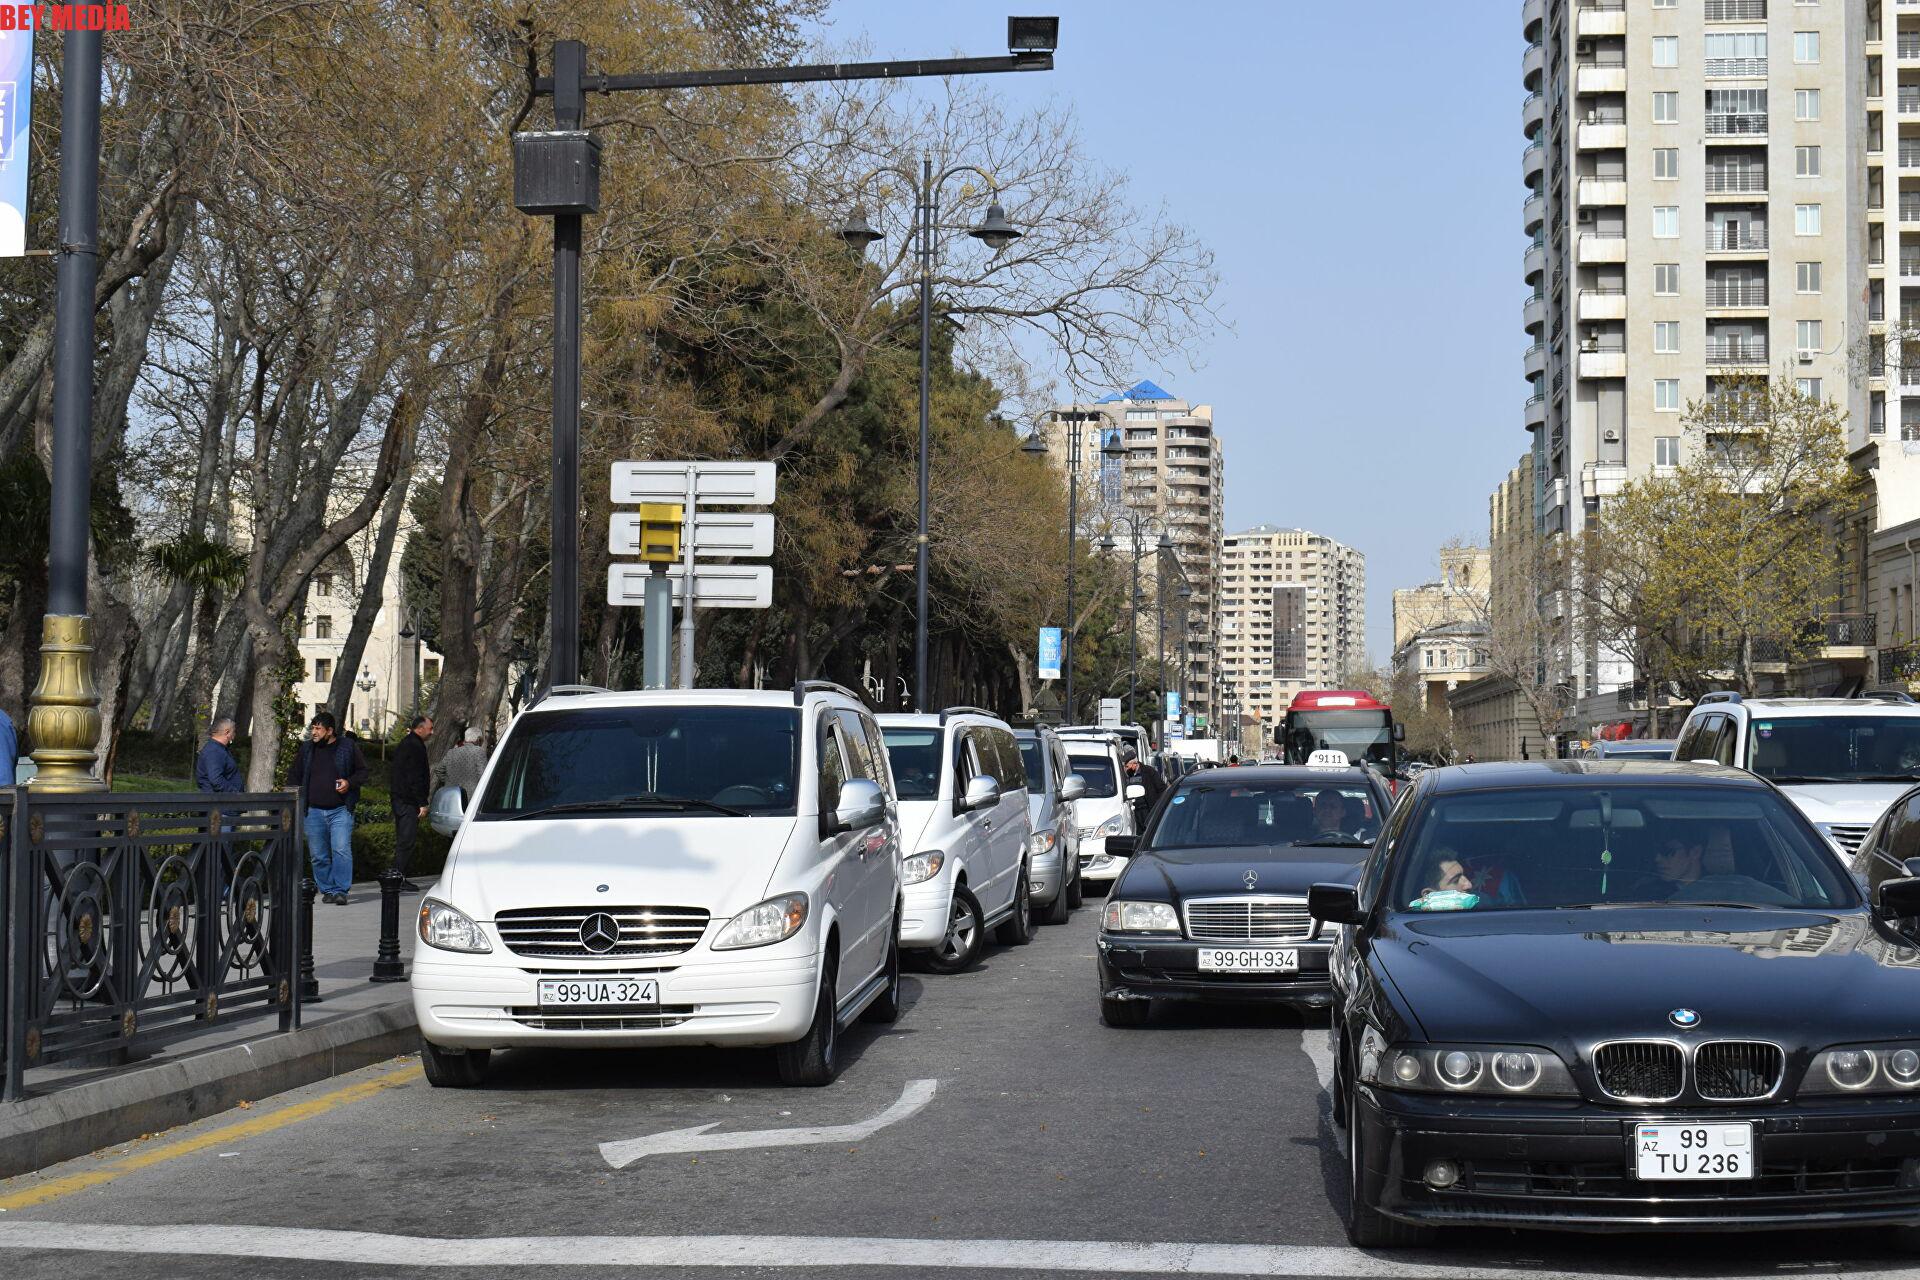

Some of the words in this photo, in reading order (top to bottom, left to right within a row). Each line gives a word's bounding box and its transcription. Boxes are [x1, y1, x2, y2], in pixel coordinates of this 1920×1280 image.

[1214, 951, 1294, 967] 99-GH-934
[543, 993, 554, 1001] AZ
[557, 982, 652, 1002] 99-UA-324
[1642, 1141, 1659, 1152] AZ
[1680, 1129, 1708, 1149] 99
[1655, 1153, 1688, 1173] TU
[1697, 1153, 1739, 1174] 236
